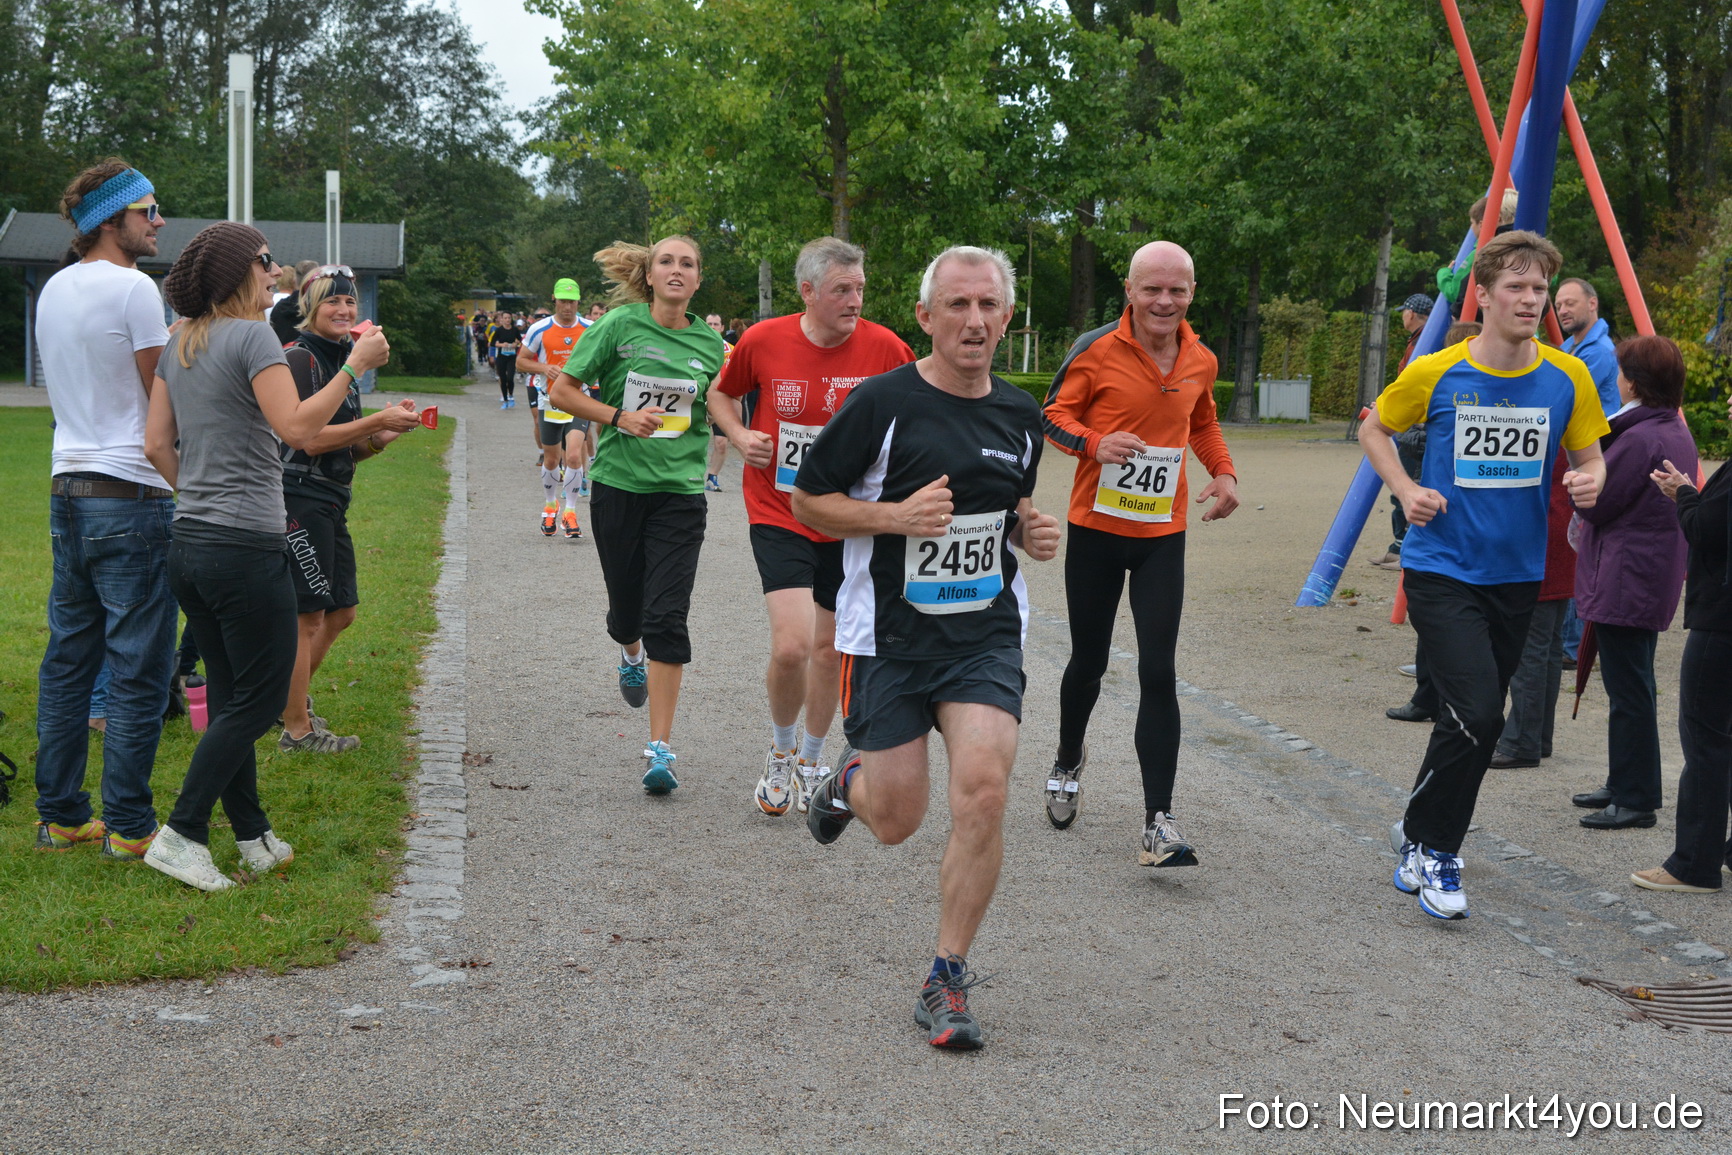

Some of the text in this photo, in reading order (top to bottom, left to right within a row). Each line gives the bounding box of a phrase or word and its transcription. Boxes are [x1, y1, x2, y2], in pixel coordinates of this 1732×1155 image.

[628, 378, 686, 393] PARTL Neumarkt
[636, 391, 681, 412] 212
[777, 398, 799, 406] NEU
[1458, 414, 1533, 424] PARTL Neumarkt
[780, 428, 804, 438] PARTL
[1464, 427, 1540, 457] 2526
[988, 449, 1018, 462] PFLEIDERER
[1137, 453, 1173, 462] Neumarkt
[1478, 464, 1519, 476] Sascha
[1117, 462, 1168, 493] 246
[1119, 496, 1156, 511] Roland
[949, 524, 993, 535] Neumarkt
[917, 536, 995, 576] 2458
[937, 586, 978, 600] Alfons
